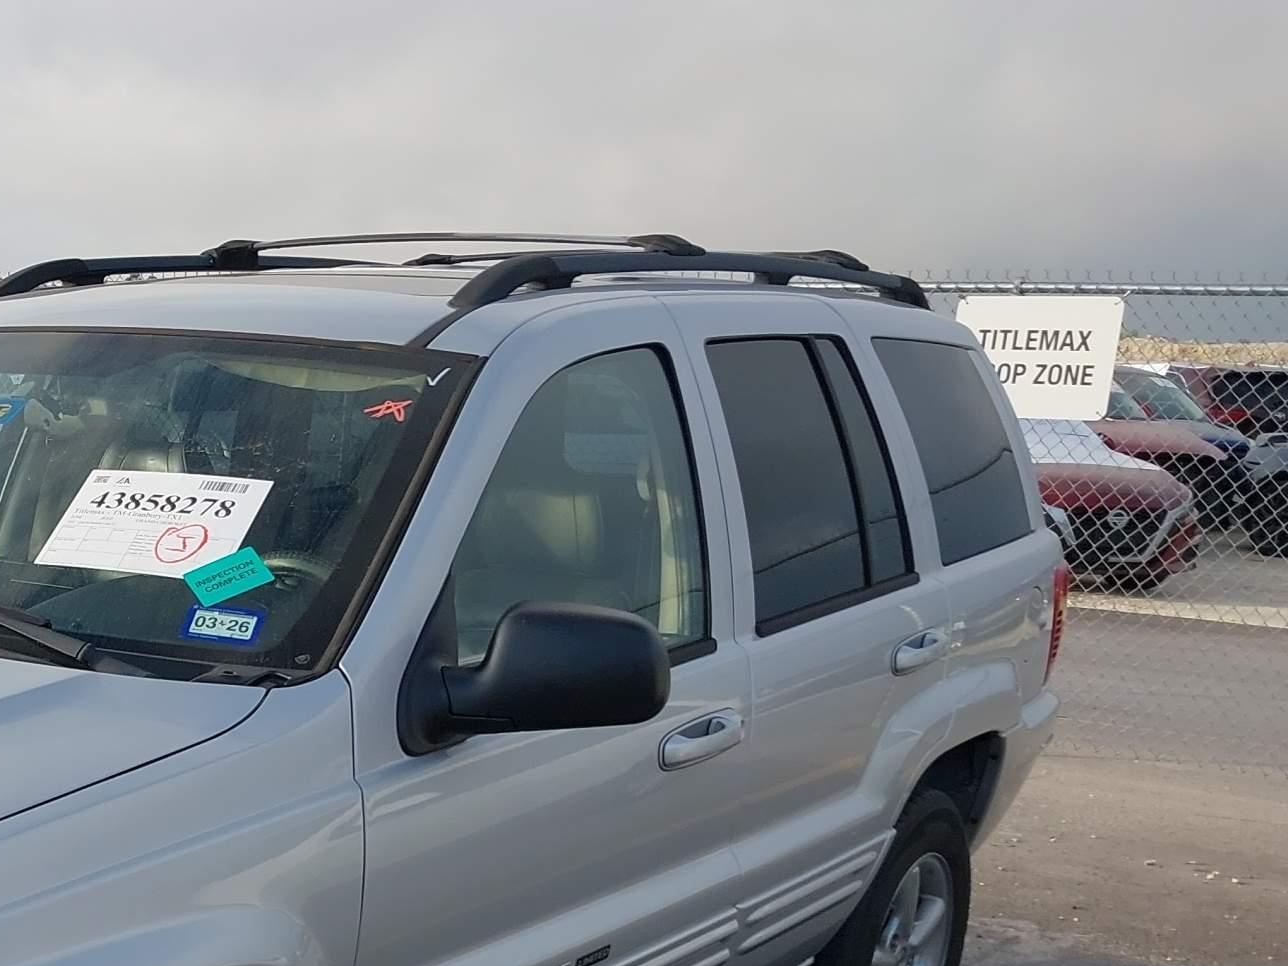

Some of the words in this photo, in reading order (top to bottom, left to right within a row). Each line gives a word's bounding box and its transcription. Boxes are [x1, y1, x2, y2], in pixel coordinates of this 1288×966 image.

[979, 329, 1092, 351] TITLEMAX
[993, 363, 1027, 385] OP
[1032, 364, 1095, 386] ZONE
[90, 491, 236, 518] 43858278
[195, 560, 254, 588] INSPECTION
[205, 568, 258, 593] COMPLETE
